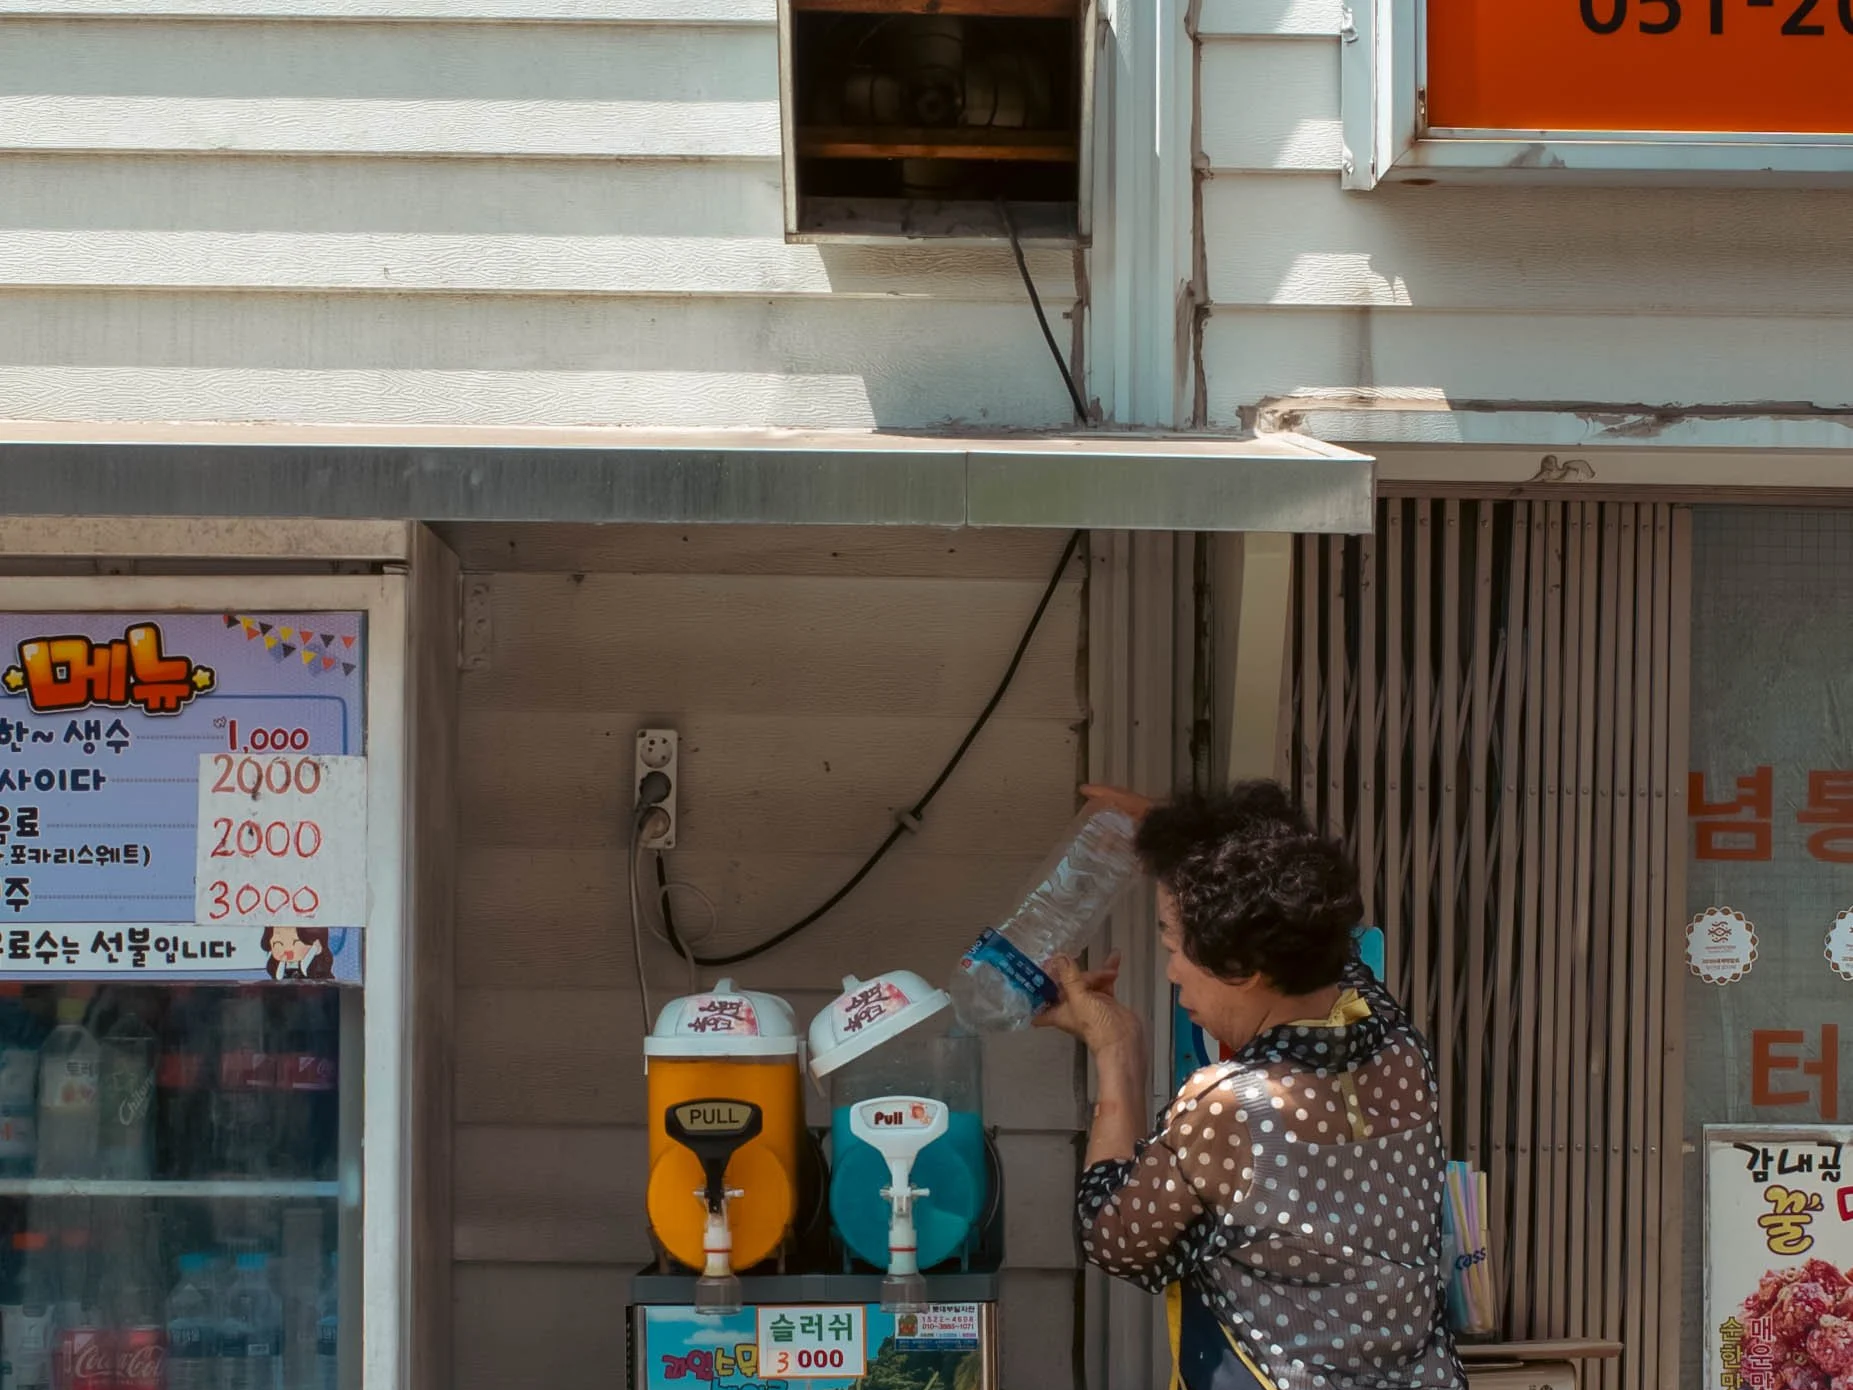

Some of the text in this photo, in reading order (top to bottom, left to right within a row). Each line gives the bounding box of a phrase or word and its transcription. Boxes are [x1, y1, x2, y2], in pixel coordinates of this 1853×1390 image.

[20, 621, 194, 715] 메뉴
[63, 719, 130, 754] 생수
[0, 768, 107, 792] 사이다
[211, 754, 321, 795] 2000
[210, 817, 322, 858] 2000
[209, 881, 320, 920] 3000
[0, 927, 237, 968] 료수는 선불입니다
[1752, 1023, 1838, 1121] 터
[689, 1109, 740, 1125] PULL
[873, 1111, 904, 1126] Pull
[1733, 1142, 1844, 1183] 감내골
[769, 1312, 854, 1343] 슬러쉬
